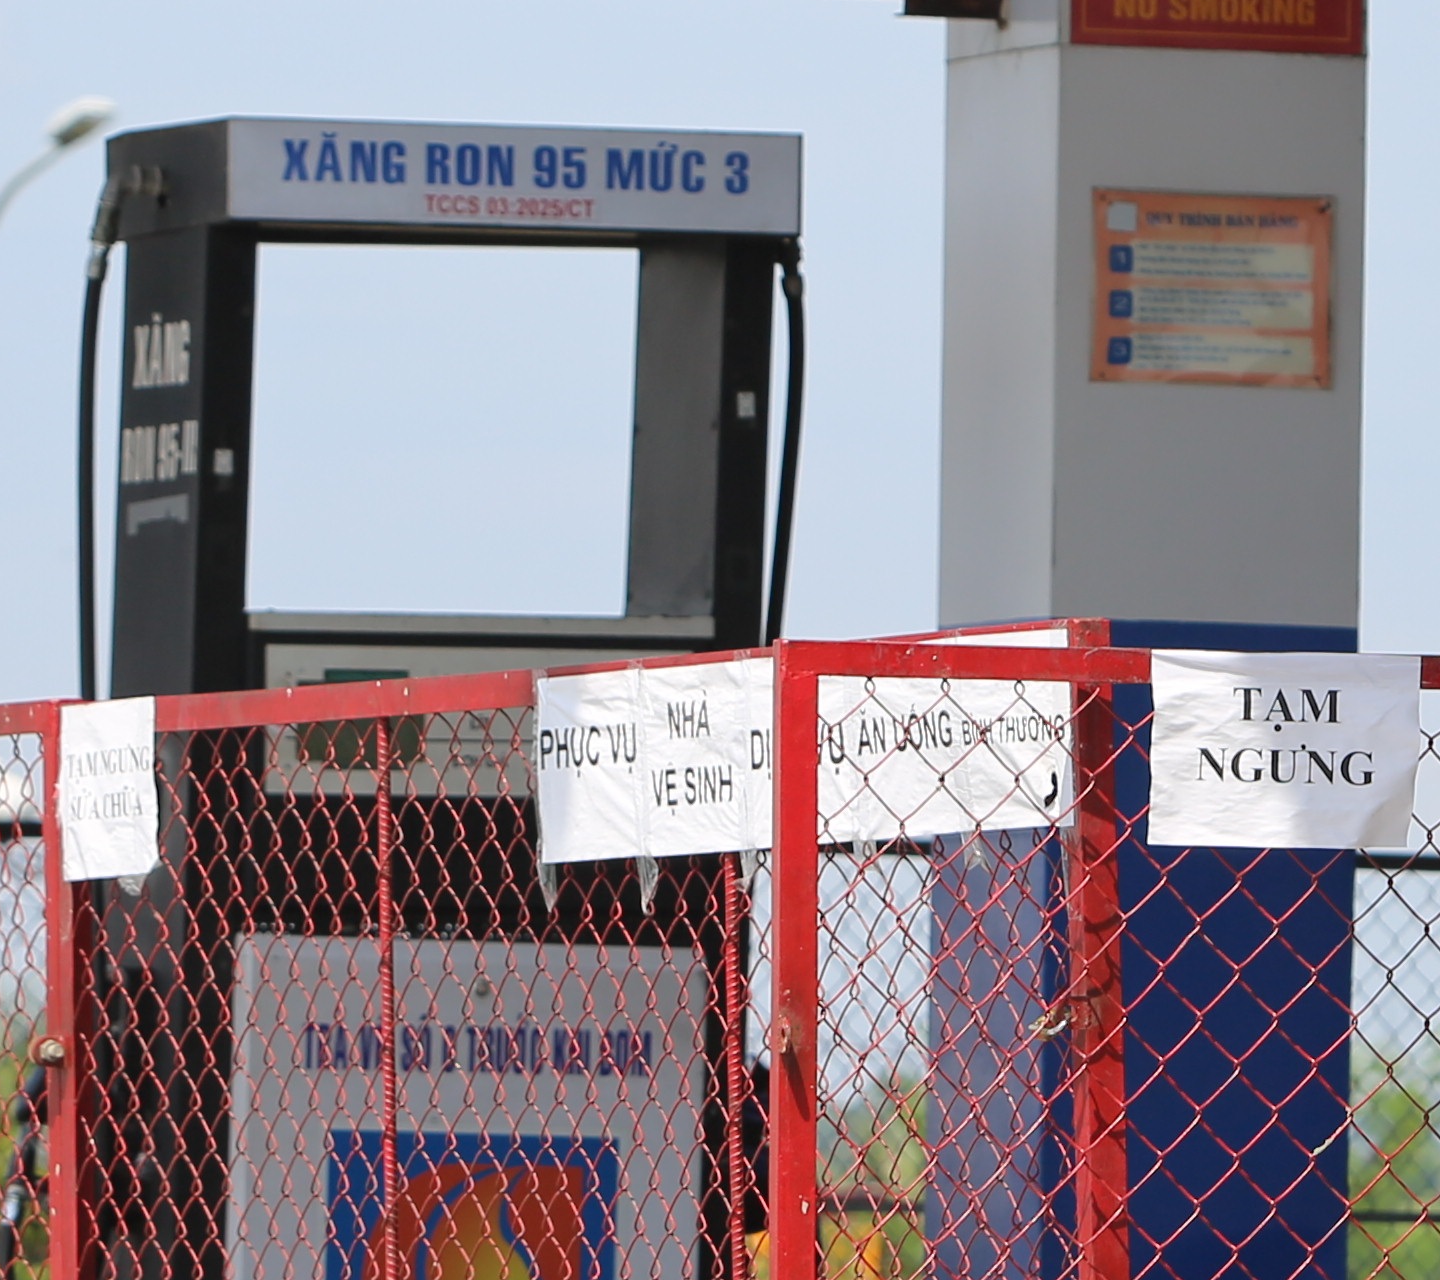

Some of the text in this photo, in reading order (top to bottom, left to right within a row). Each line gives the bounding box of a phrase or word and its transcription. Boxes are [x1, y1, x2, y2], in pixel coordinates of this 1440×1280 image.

[281, 131, 750, 195] XĂNG RON 95 MỨC 3
[424, 193, 481, 216] TCCS
[667, 688, 711, 740] NHÀ
[858, 708, 887, 756] ĂN
[893, 703, 954, 752] UỐNG
[962, 712, 993, 746] BÌNH
[1233, 687, 1341, 732] TẠM
[540, 722, 637, 778] PHỤC VỤ
[1195, 744, 1376, 787] NGƯNG
[651, 761, 733, 816] VỆ SINH
